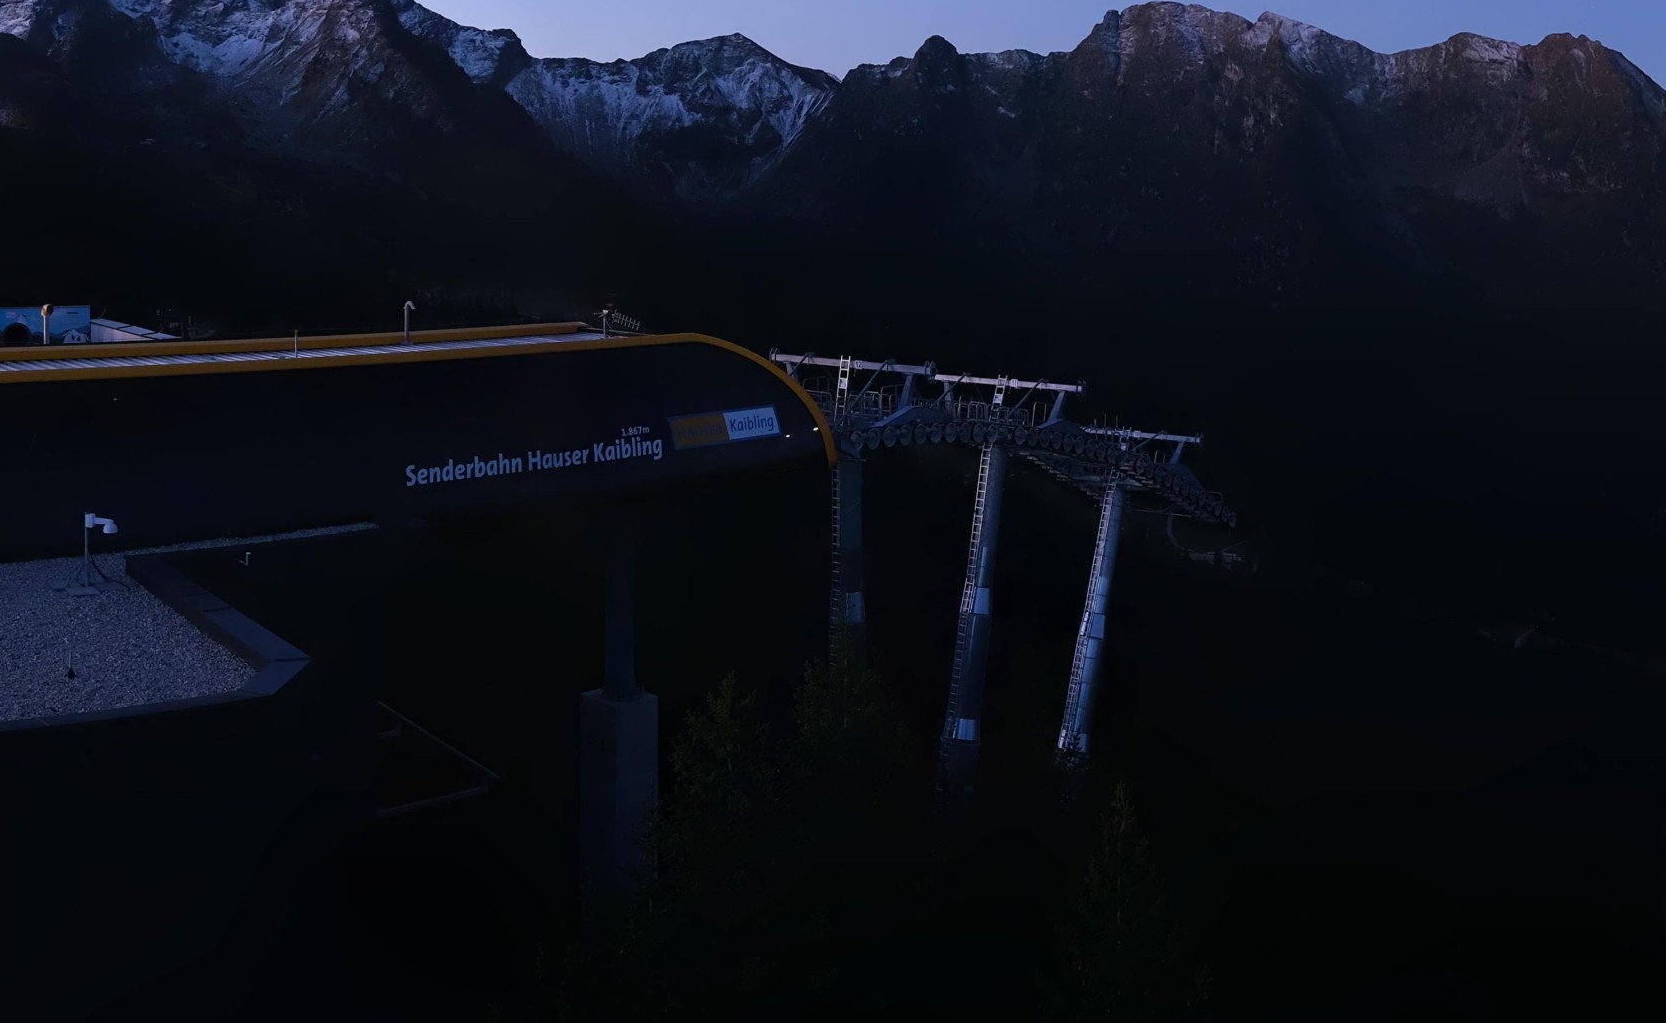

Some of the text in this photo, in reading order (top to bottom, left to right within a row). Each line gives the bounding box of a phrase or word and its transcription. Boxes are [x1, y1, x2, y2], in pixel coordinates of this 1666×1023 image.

[621, 426, 650, 437] 1.867m
[730, 414, 774, 433] Kaibling
[405, 437, 663, 487] Senderbahn Hauser Kaibling
